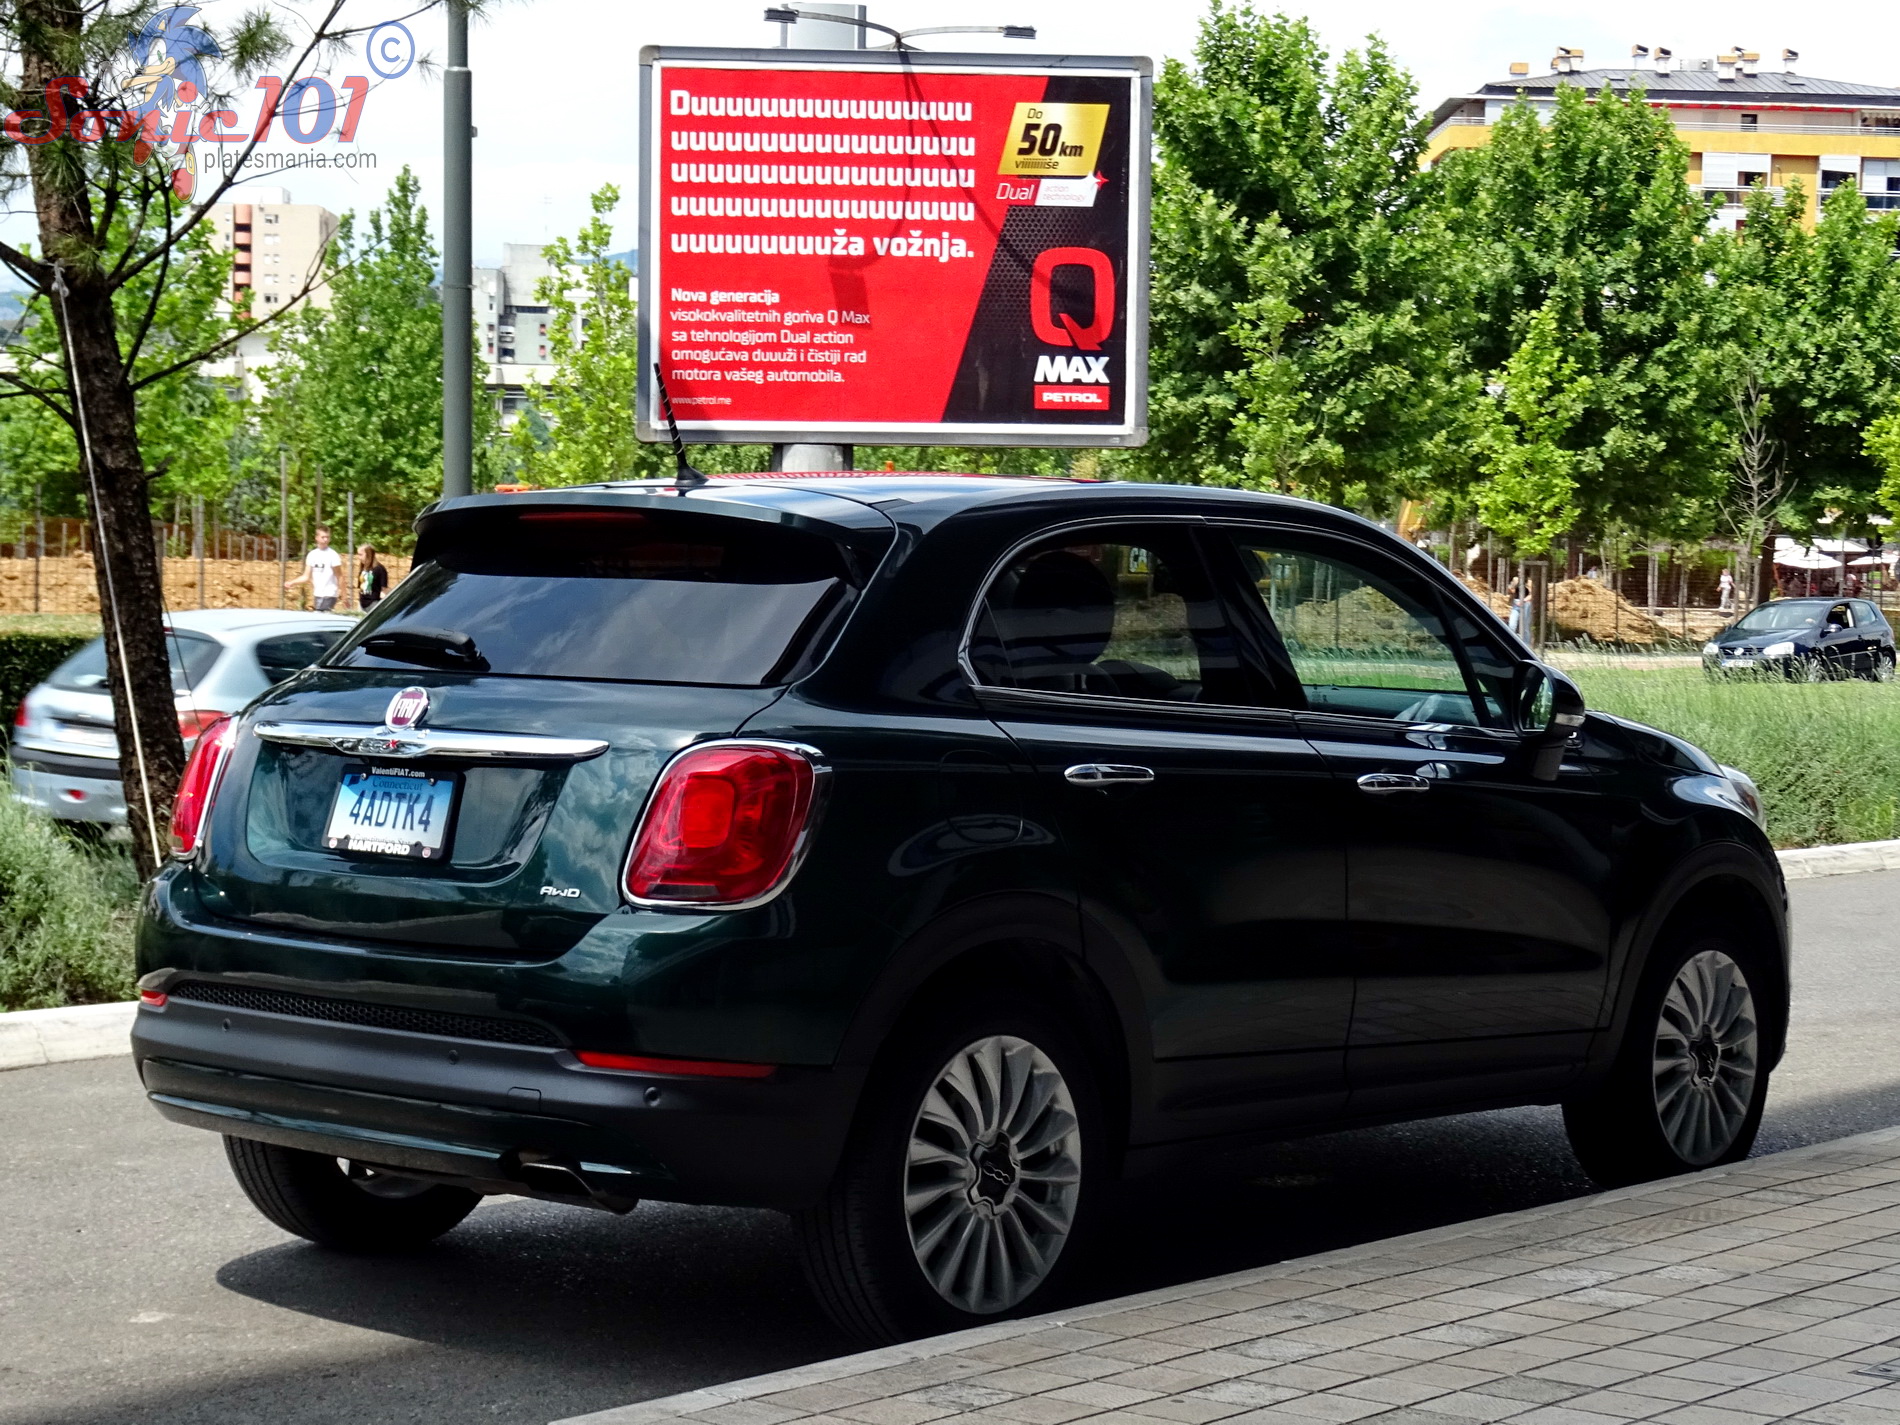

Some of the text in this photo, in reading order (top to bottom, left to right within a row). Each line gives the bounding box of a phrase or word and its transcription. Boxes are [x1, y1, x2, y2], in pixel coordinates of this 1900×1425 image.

[1027, 108, 1043, 119] Do
[1017, 123, 1084, 157] 50 km
[996, 183, 1034, 200] Dual
[873, 230, 974, 262] vožnja.
[671, 288, 779, 305] Nova generacija
[1030, 247, 1115, 350] Q
[670, 309, 870, 325] visokokvalitetnih goriva Q Max
[672, 329, 853, 345] sa tehnologijom Dual action
[672, 348, 866, 365] omogućava duuuži i čistiji rad
[672, 368, 844, 384] motora vašeg automobila.
[1034, 356, 1110, 383] MAX
[672, 396, 731, 404] www.petrol.me
[1042, 393, 1102, 403] PETROL
[393, 698, 421, 718] FIAT
[372, 767, 425, 777] ValentiFIAT.com
[372, 778, 423, 790] Connecticut
[349, 790, 434, 832] 4ADTK4
[348, 840, 410, 855] HARTFORD
[540, 886, 580, 898] AWD
